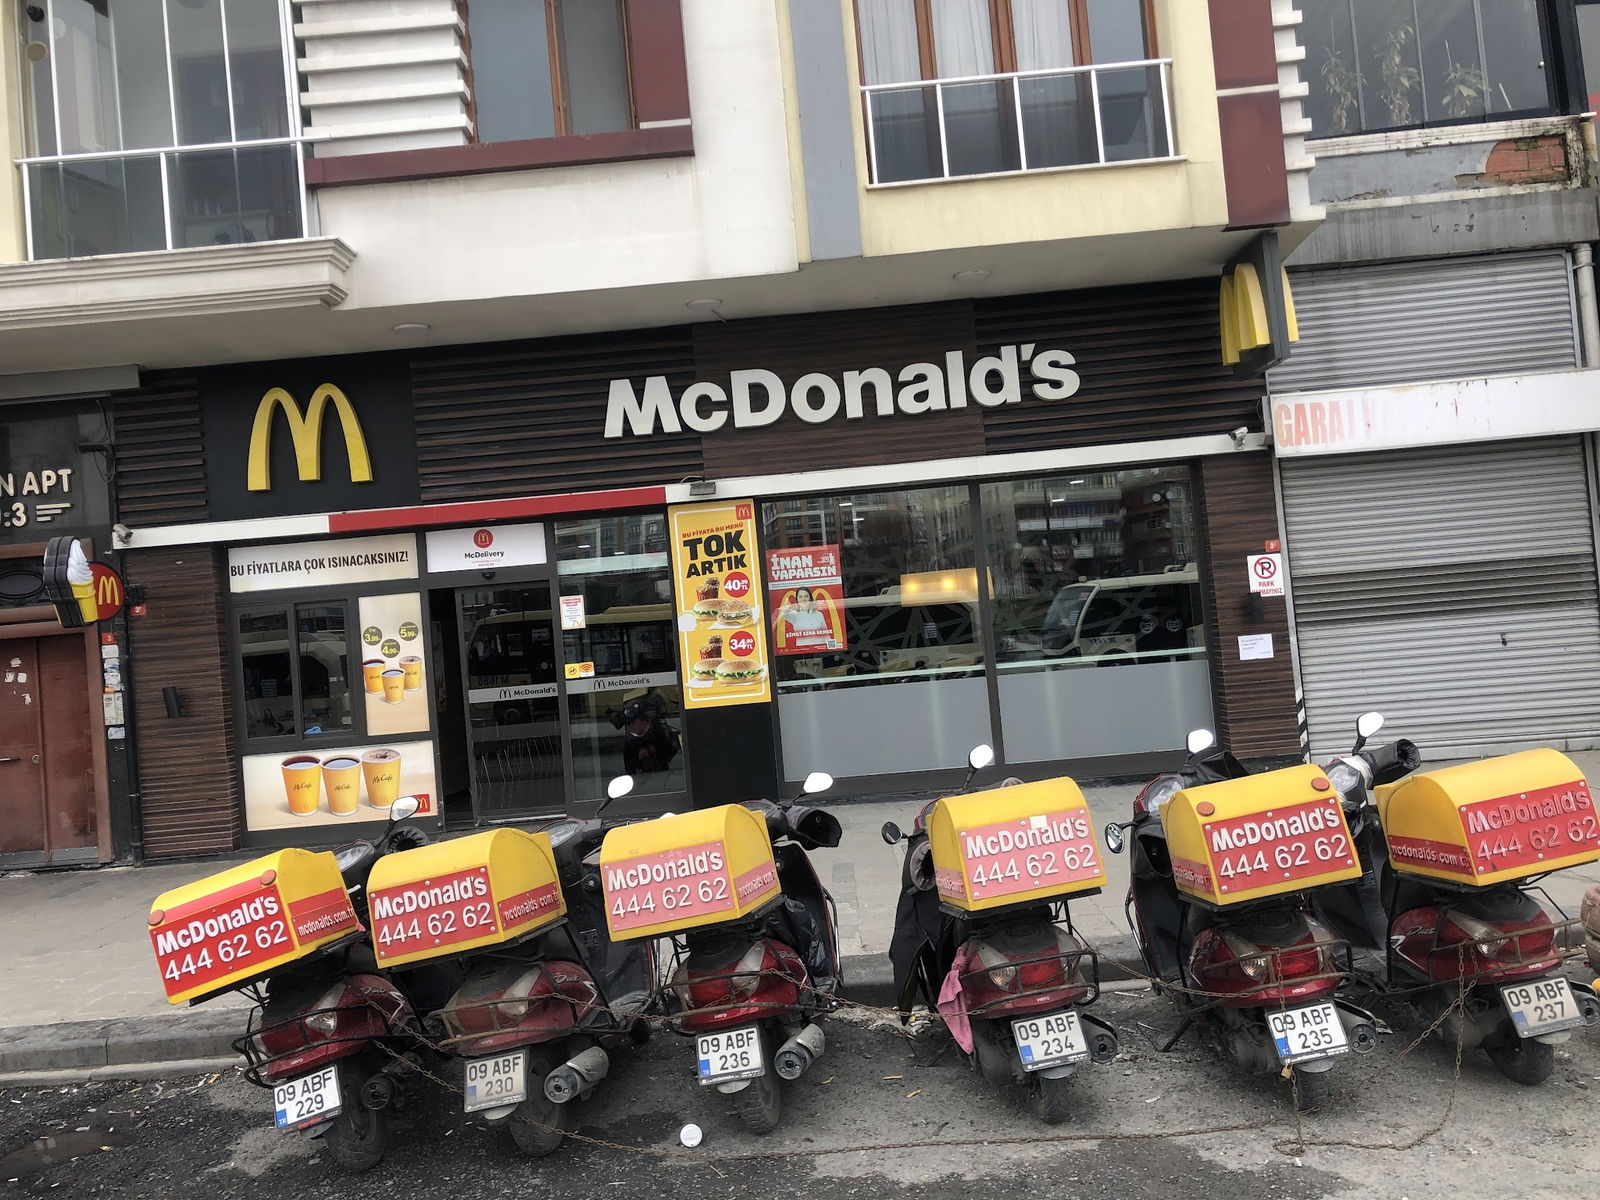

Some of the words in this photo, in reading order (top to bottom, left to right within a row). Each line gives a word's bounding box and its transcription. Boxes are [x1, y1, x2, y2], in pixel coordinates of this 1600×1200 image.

[603, 343, 1081, 439] McDonald's
[1275, 400, 1356, 447] GARA
[22, 468, 72, 496] APT
[464, 550, 504, 559] McDelivery
[683, 529, 746, 561] TOK
[230, 564, 245, 577] BU
[247, 560, 302, 575] FİYATLARA
[304, 557, 325, 574] ÇOK
[328, 550, 409, 569] ISINACAKSINIZ!
[686, 554, 747, 578] ARTIK
[771, 553, 813, 570] İNAN
[771, 566, 837, 580] YAPARSIN
[513, 686, 556, 696] McDonald's
[607, 677, 650, 687] McDonald's
[1467, 790, 1590, 834] McDonald's
[967, 817, 1089, 859] McDonald's
[1211, 807, 1340, 852] McDonald's
[1477, 832, 1523, 861] 444
[1529, 824, 1560, 850] 62
[1567, 816, 1599, 842] 62
[972, 857, 1020, 886] 444
[1026, 851, 1059, 877] 62
[1064, 844, 1097, 870] 62
[1220, 850, 1269, 879] 444
[1274, 842, 1310, 869] 62
[1314, 834, 1348, 861] 62
[608, 851, 723, 892] McDonald's
[374, 876, 488, 920] McDonald's
[612, 890, 656, 919] 444
[662, 884, 693, 910] 62
[698, 876, 728, 902] 62
[156, 895, 279, 956] McDonald's
[378, 917, 422, 946] 444
[427, 910, 457, 936] 62
[462, 902, 493, 928] 62
[164, 948, 213, 981] 444
[218, 933, 251, 962] 62
[255, 920, 288, 949] 62
[1507, 988, 1532, 1007] 09
[1534, 980, 1564, 1002] ABF
[1272, 1014, 1296, 1033] 09
[1300, 1006, 1331, 1028] ABF
[1533, 1001, 1564, 1022] 237
[1017, 1022, 1040, 1041] 09
[1045, 1014, 1075, 1035] ABF
[1298, 1028, 1333, 1049] 235
[700, 1037, 720, 1055] 09
[725, 1031, 755, 1051] ABF
[1041, 1036, 1075, 1056] 234
[469, 1063, 488, 1081] 09
[492, 1056, 521, 1076] ABF
[719, 1051, 750, 1071] 236
[276, 1084, 296, 1105] 09
[301, 1069, 333, 1097] ABF
[485, 1076, 514, 1097] 230
[295, 1093, 324, 1119] 229
